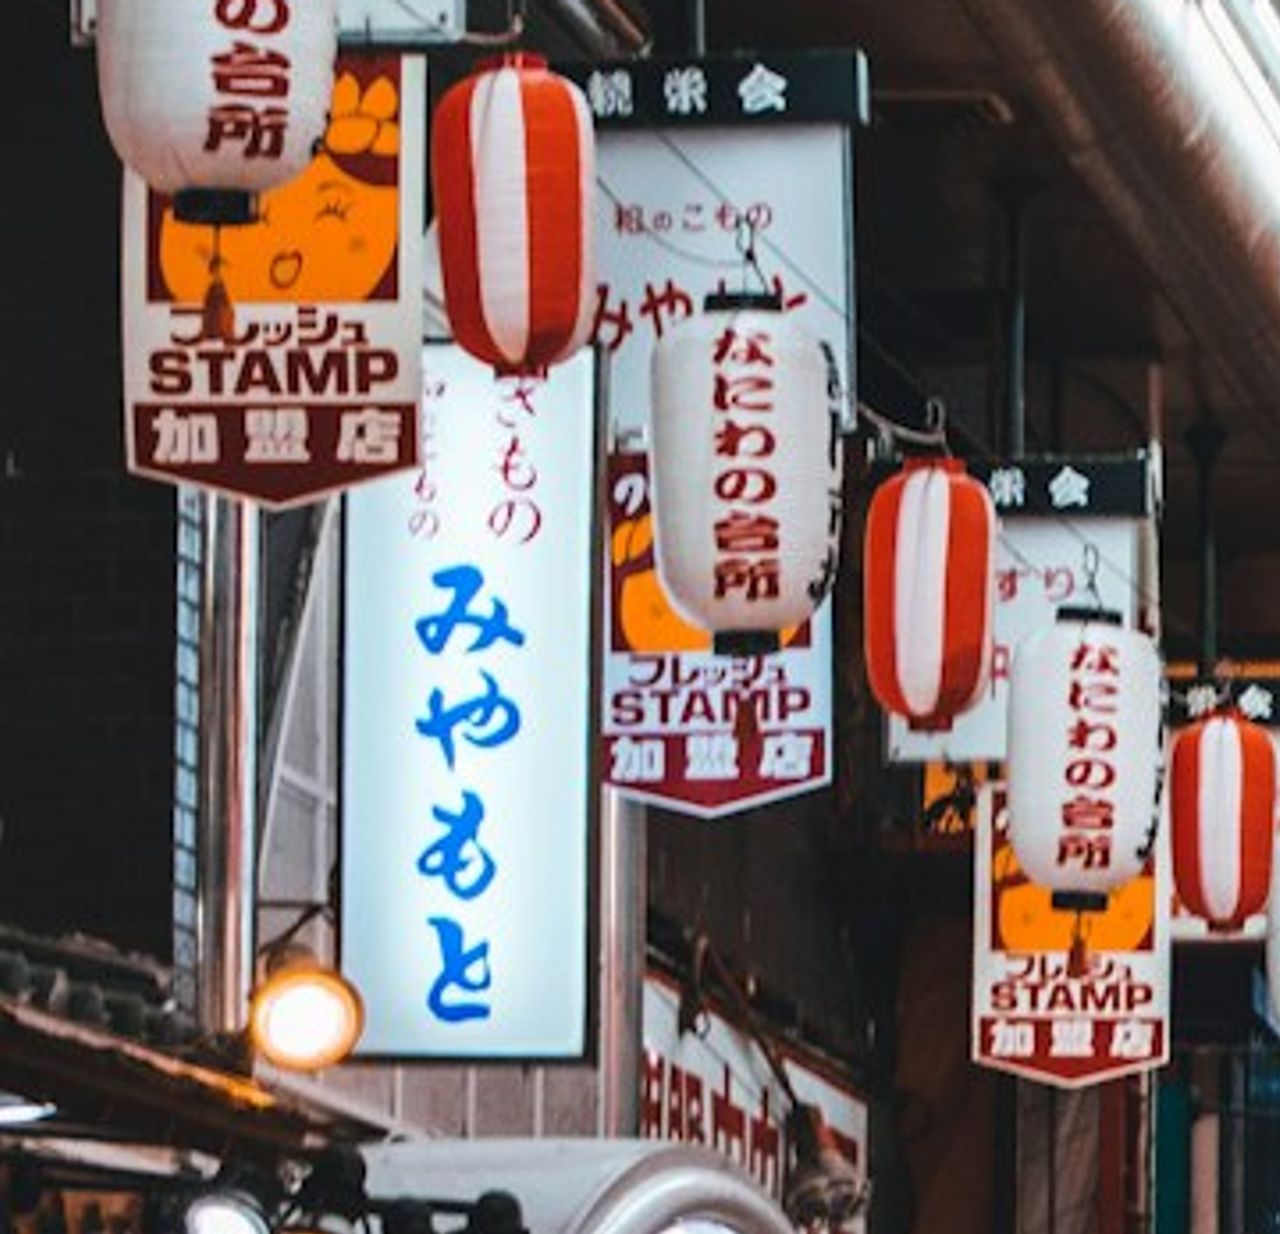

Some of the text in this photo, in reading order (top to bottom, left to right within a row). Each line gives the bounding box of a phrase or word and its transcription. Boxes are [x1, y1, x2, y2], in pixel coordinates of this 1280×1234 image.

[202, 0, 290, 160] の台所
[149, 350, 398, 396] STAMP
[152, 407, 401, 464] 加盟店
[713, 325, 780, 603] なにわの台所
[611, 687, 811, 727] STAMP
[610, 732, 814, 783] 加盟店
[1056, 641, 1121, 871] なにわの台所
[413, 563, 526, 1024] みやもと
[990, 980, 1153, 1012] STAMP
[990, 1017, 1154, 1058] 加盟店
